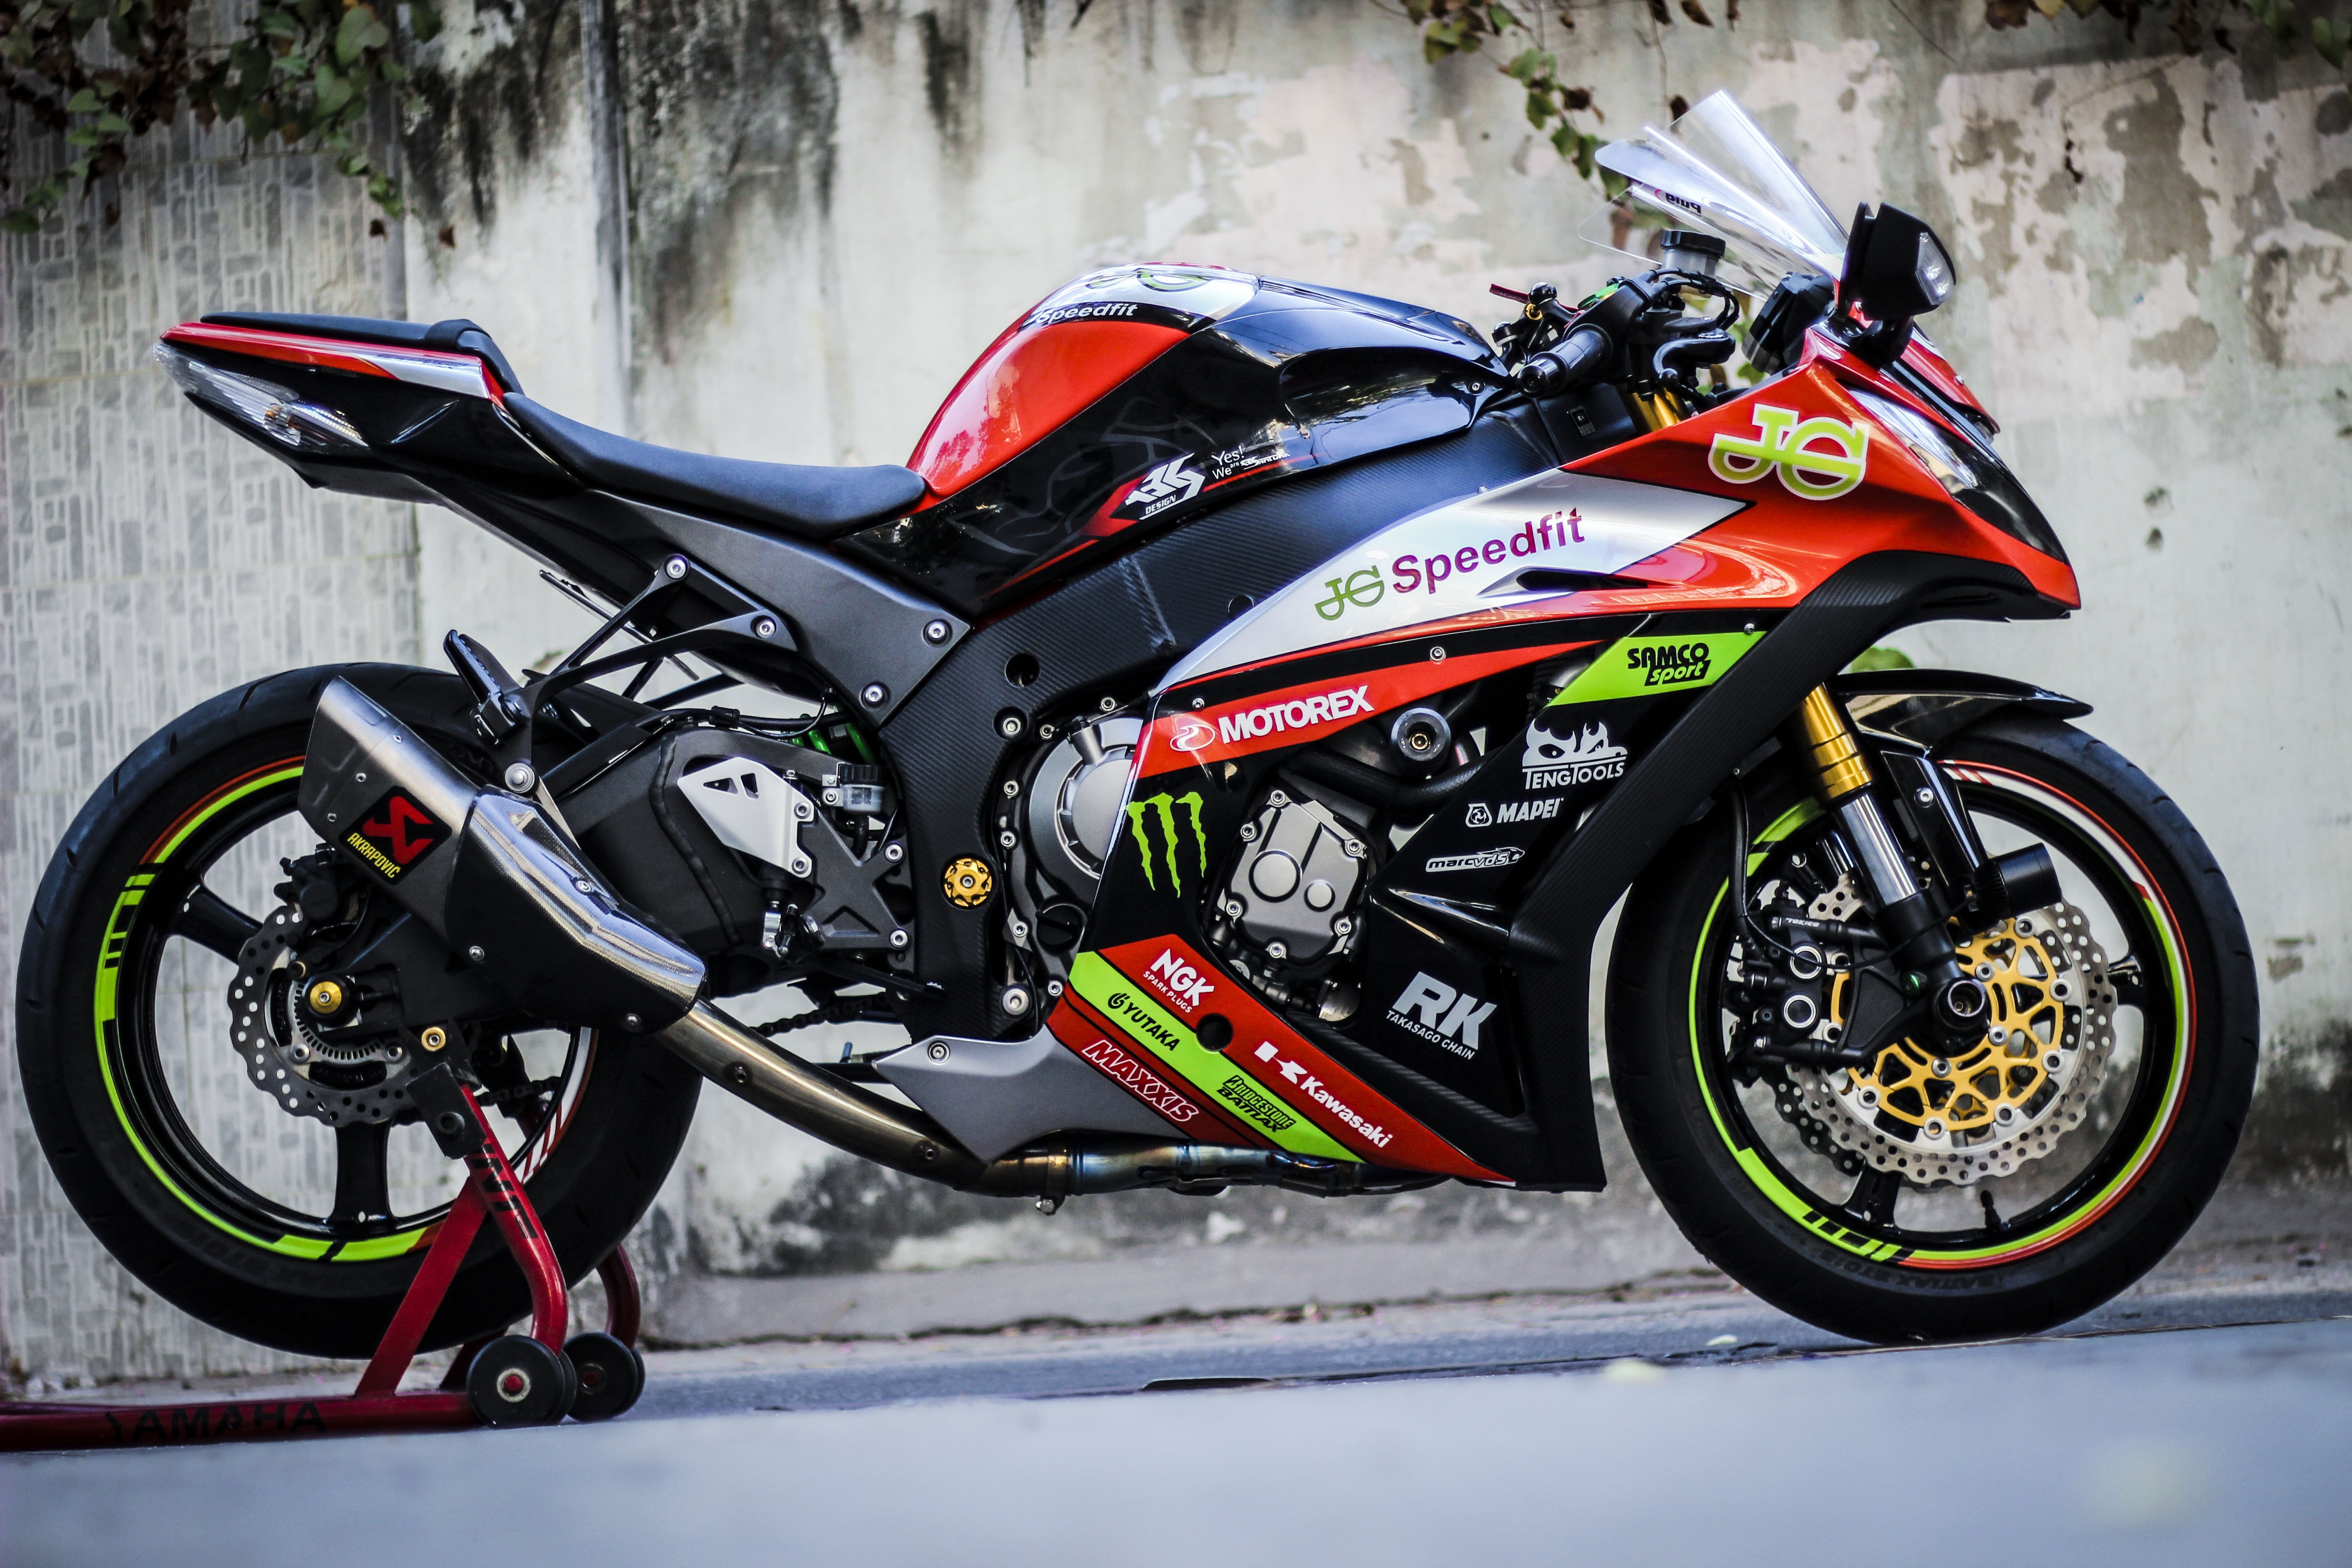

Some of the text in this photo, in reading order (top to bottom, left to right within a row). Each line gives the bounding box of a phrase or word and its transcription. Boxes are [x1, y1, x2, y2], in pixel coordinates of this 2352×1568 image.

[1036, 303, 1138, 324] Speedfit
[1211, 445, 1244, 466] Yes!
[1212, 467, 1232, 480] We
[1145, 495, 1176, 514] DESIGN
[1392, 507, 1585, 595] Speedfit
[1627, 642, 1710, 669] SAMCO
[1217, 685, 1375, 744] MOTOREX
[1496, 799, 1563, 824] MAPEI
[1785, 917, 1820, 927] TOKICO
[1143, 970, 1192, 1014] SPARK PLUGS
[1150, 948, 1215, 1006] NGK
[1122, 1002, 1181, 1052] YUTAKA
[1392, 971, 1497, 1050] RK
[1386, 1010, 1475, 1060] TAKASAGO CHAIN
[1081, 1039, 1200, 1122] MAXXIS
[1222, 1074, 1297, 1131] BRIDGESTONE
[1216, 1087, 1287, 1133] BATTLAX
[1298, 1075, 1394, 1148] Kawasaki
[105, 1402, 328, 1442] YAMAHA
